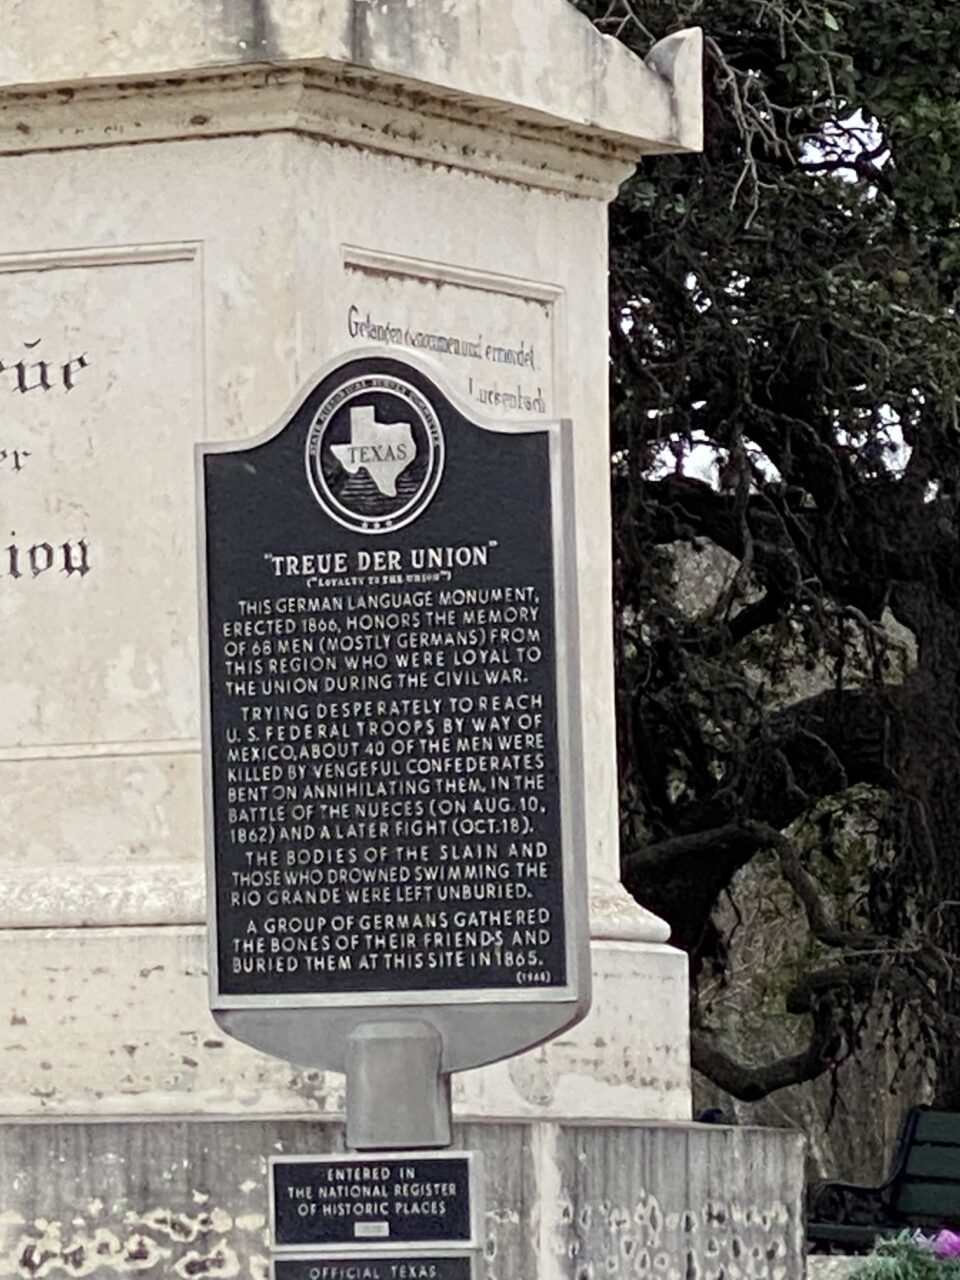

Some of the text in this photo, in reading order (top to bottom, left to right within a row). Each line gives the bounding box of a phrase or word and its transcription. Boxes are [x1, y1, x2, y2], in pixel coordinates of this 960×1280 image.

[347, 443, 407, 464] TEXAS
[264, 540, 499, 576] "TREUE DER UNION"
[368, 575, 380, 585] TO
[382, 574, 403, 586] THE
[238, 586, 540, 615] THIS GERMAN LANGUAGE MONUMENT,
[223, 606, 539, 637] ERECTED 1866, HONORS THE MEMORY
[224, 628, 540, 657] OF 68 MEN (MOSTLY GERMANS) FROM
[224, 646, 542, 675] THIS REGION WHO WERE LOYAL TO
[225, 667, 529, 696] THE UNION DURING THE CIVIL WAR.
[240, 694, 543, 721] TRYING DESPERATELY TO REACH
[265, 723, 350, 741] FEDERAL
[356, 718, 435, 737] TROOPS
[443, 717, 464, 734] BY
[471, 715, 511, 732] WAY
[517, 713, 542, 730] OF
[299, 741, 360, 759] ABOUT
[365, 740, 385, 757] 40
[391, 739, 415, 755] OF
[419, 737, 451, 754] THE
[456, 736, 493, 753] MEN
[497, 733, 544, 751] WERE
[227, 753, 544, 783] KILLED BY VENGEFUL CONFEDERATES
[228, 785, 268, 803] BENT
[272, 785, 297, 800] ON
[303, 778, 430, 799] ANNIHILATING
[491, 775, 510, 790] IN
[513, 774, 544, 790] THE
[228, 805, 285, 823] BATTLE
[291, 804, 313, 821] OF
[319, 803, 349, 819] THE
[355, 800, 424, 818] NUECES
[429, 799, 466, 817] (ON
[230, 826, 276, 844] 1862)
[279, 825, 315, 841] AND
[319, 825, 331, 840] A
[335, 821, 389, 839] LATER
[395, 819, 447, 836] FIGHT
[245, 841, 548, 866] THE BODIES OF THE SLAIN AND
[231, 863, 548, 887] THOSE WHO DROWNED SWIMMING THE
[231, 882, 533, 907] RIO GRANDE WERE LEFT UNBURIED.
[246, 907, 550, 934] A GROUP OF GERMANS GATHERED
[233, 929, 550, 954] THE BONES OF THEIR FRIENDS AND
[233, 950, 544, 974] BURIED THEM AT THIS SITE IN 1865.
[327, 1167, 416, 1182] ENTERED IN
[288, 1182, 457, 1200] THE NATIONAL REGISTER
[297, 1200, 447, 1217] OF HISTORIC PLACES
[309, 1265, 437, 1280] OFFICIAL TEXAS
